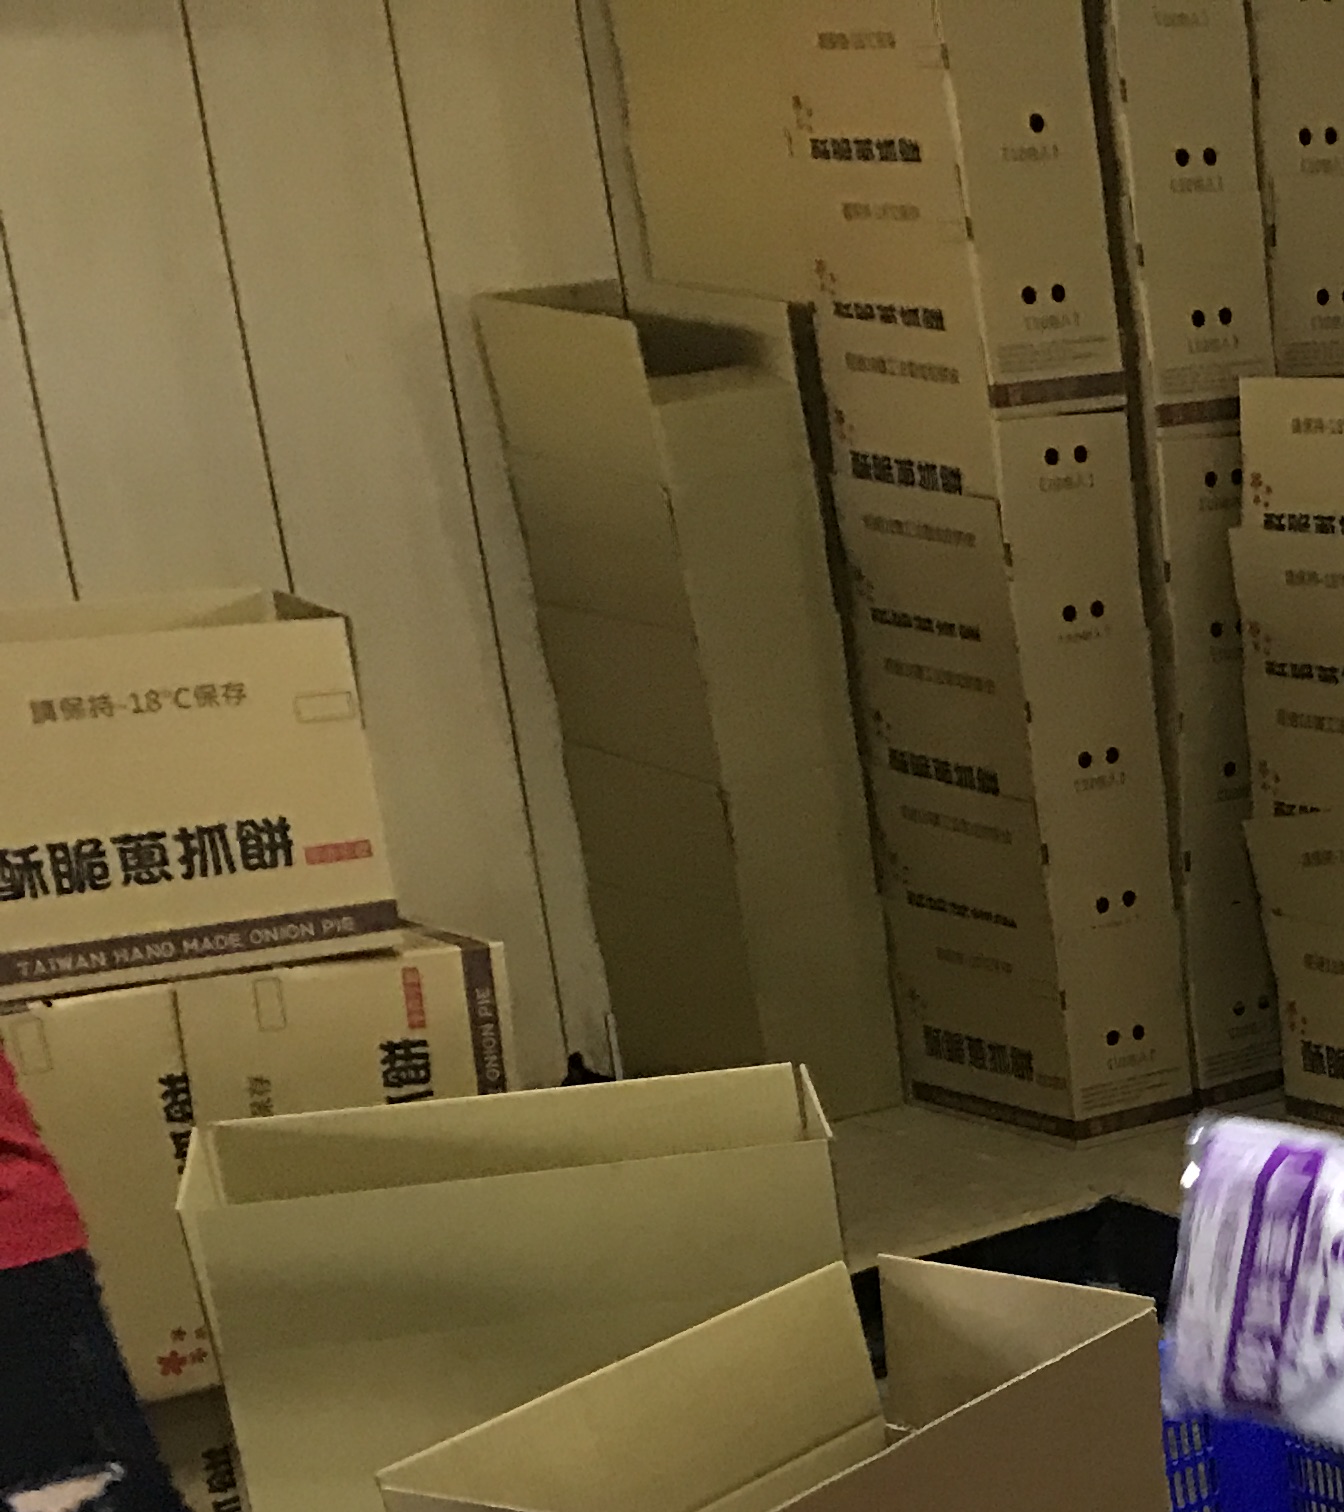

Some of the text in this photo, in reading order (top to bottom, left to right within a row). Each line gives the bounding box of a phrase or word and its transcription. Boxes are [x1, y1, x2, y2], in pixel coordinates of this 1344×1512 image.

[17, 916, 355, 978] TAIWAN HAND MADE ONION PIE
[475, 987, 501, 1082] ONION PIE
